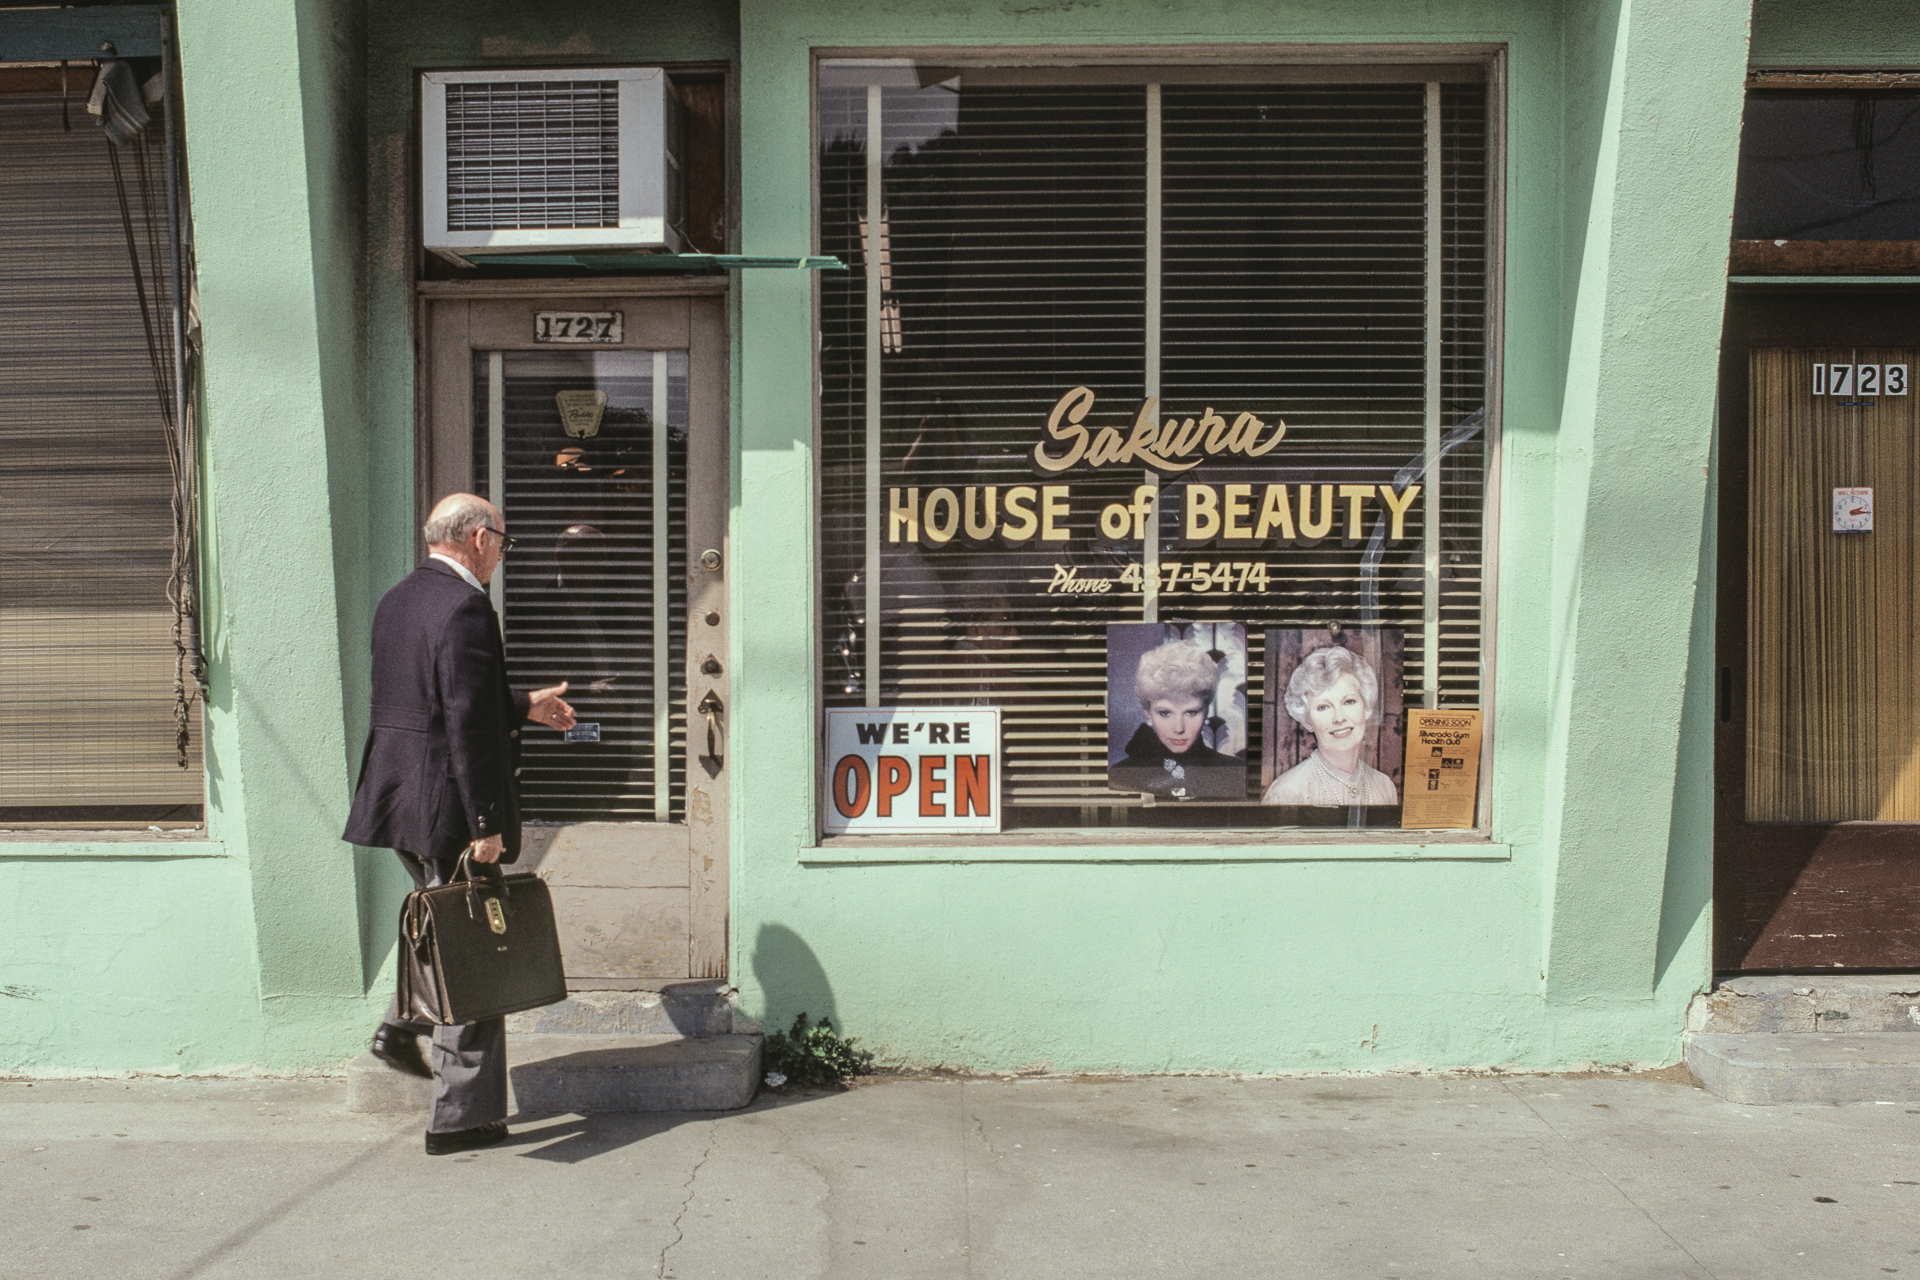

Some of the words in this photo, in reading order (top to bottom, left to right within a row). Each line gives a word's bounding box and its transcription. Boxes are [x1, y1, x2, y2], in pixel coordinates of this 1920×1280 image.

[541, 317, 617, 338] 1727
[1815, 366, 1905, 394] 1723
[1034, 386, 1286, 472] Sakura
[889, 485, 1070, 543] HOUSE
[1101, 485, 1157, 541] of
[1185, 484, 1421, 541] BEAUTY
[1048, 563, 1112, 593] Phone
[1120, 562, 1270, 592] 437-5474
[856, 722, 970, 745] WE'RE
[1419, 719, 1450, 727] OPENING
[1451, 719, 1472, 727] SOON
[1453, 731, 1470, 740] Gym
[832, 753, 991, 819] OPEN
